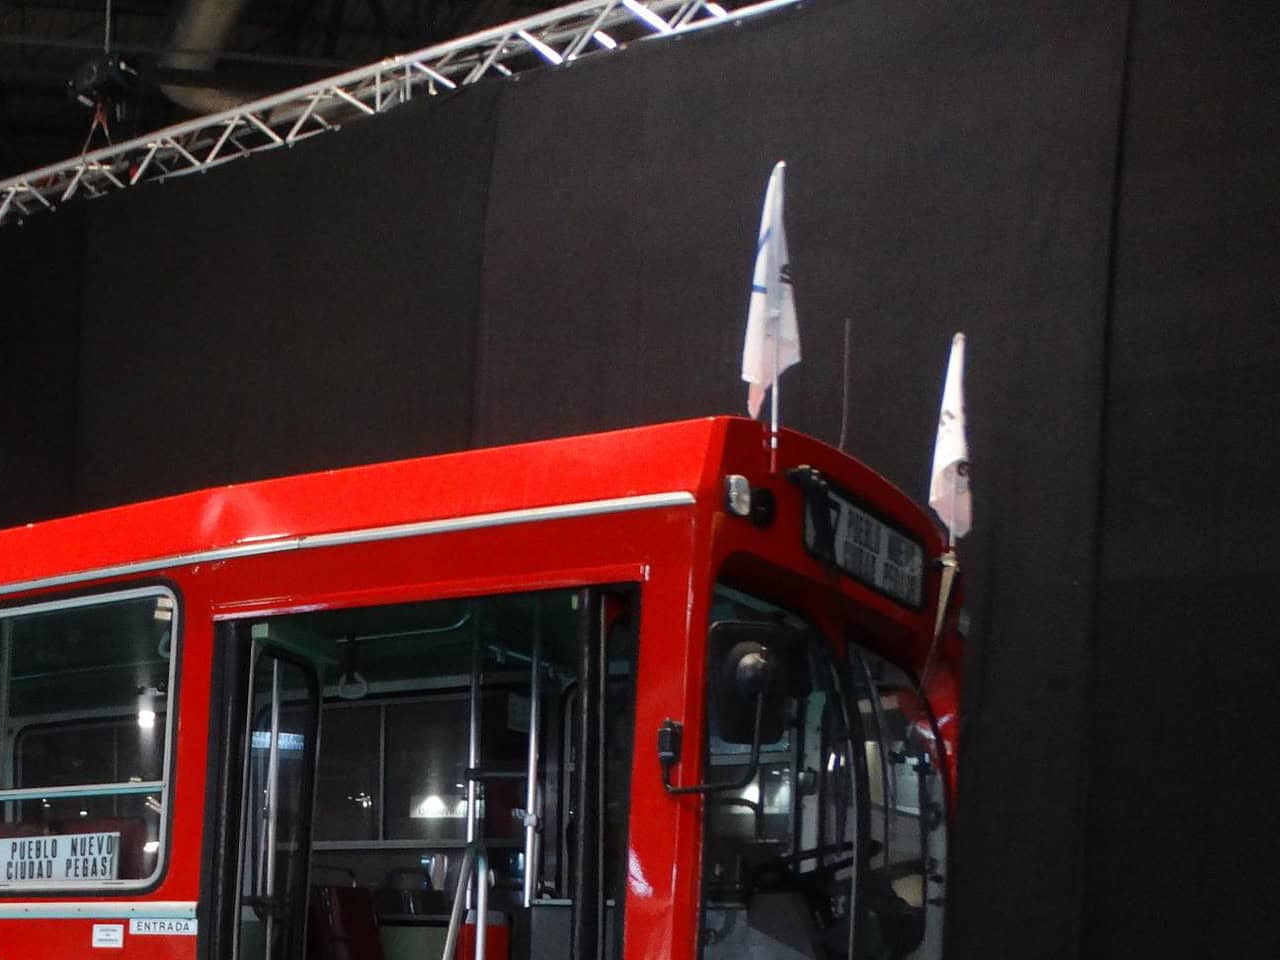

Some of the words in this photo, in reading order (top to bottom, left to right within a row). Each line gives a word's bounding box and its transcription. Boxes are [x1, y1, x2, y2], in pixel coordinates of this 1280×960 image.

[11, 838, 57, 860] PUEBLO
[71, 834, 113, 856] NUEVO
[6, 859, 53, 880] CIUDAD
[136, 921, 190, 931] ENTRADA
